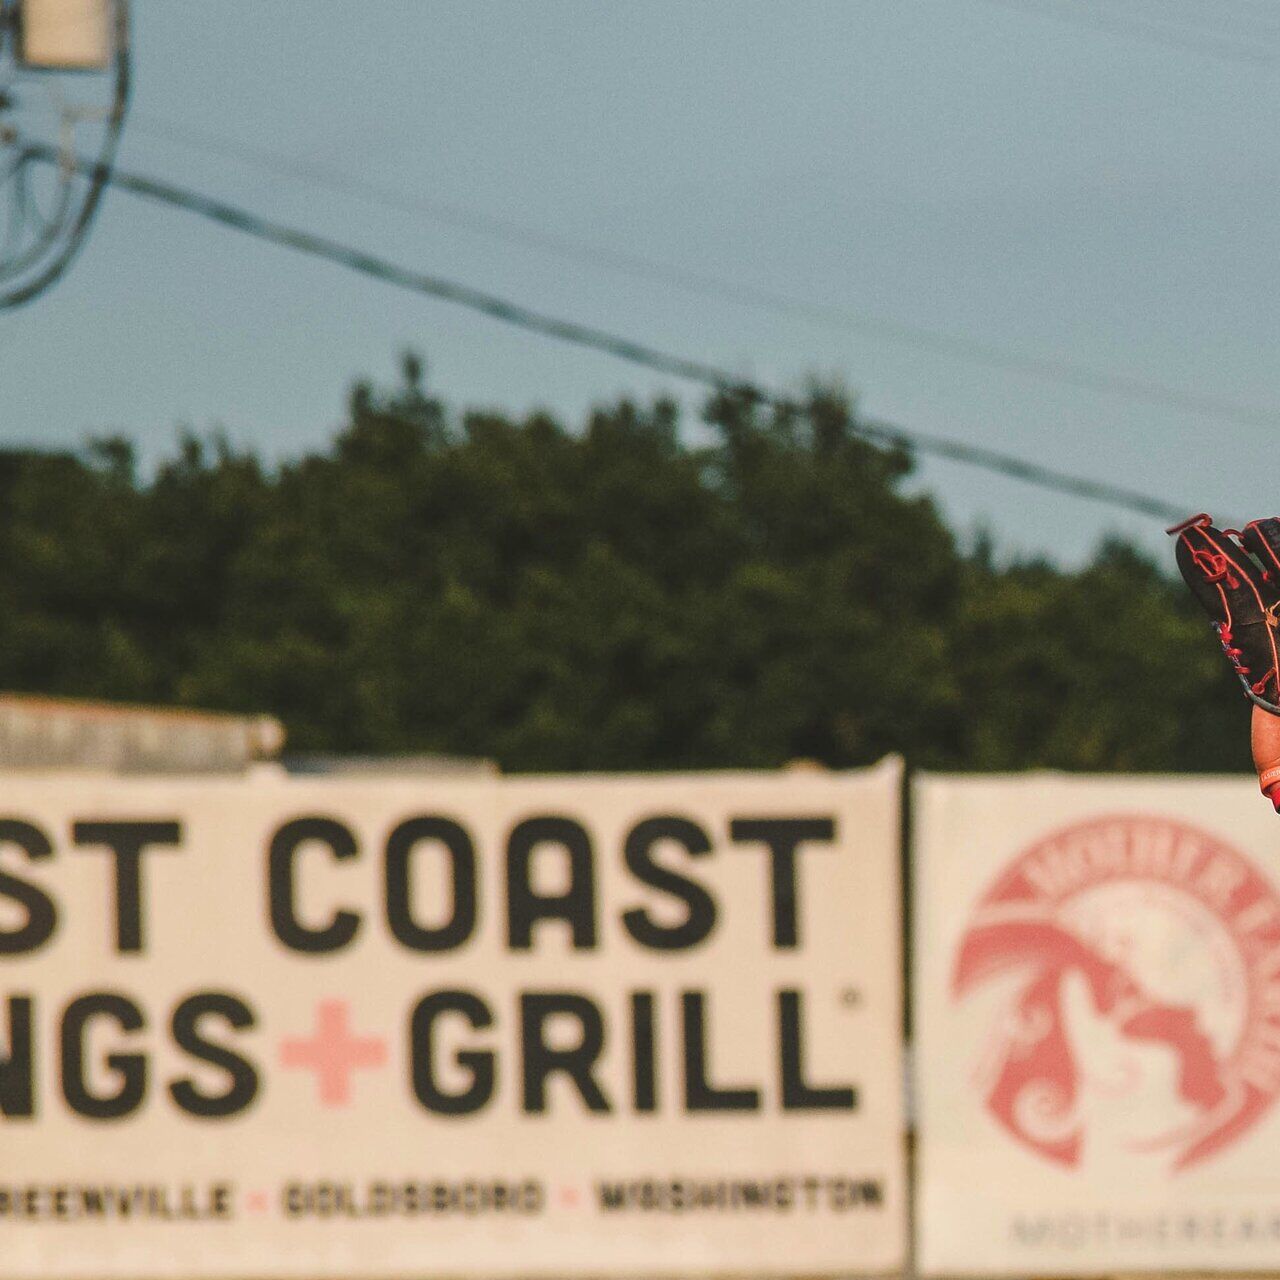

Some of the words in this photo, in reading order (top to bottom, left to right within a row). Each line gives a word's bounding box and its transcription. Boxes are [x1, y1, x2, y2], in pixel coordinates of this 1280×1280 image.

[0, 814, 186, 956] ST
[266, 812, 838, 956] COAST
[406, 985, 860, 1120] GRILL
[280, 1180, 546, 1219] GOLDSBORO
[594, 1177, 886, 1216] WASHINGTON
